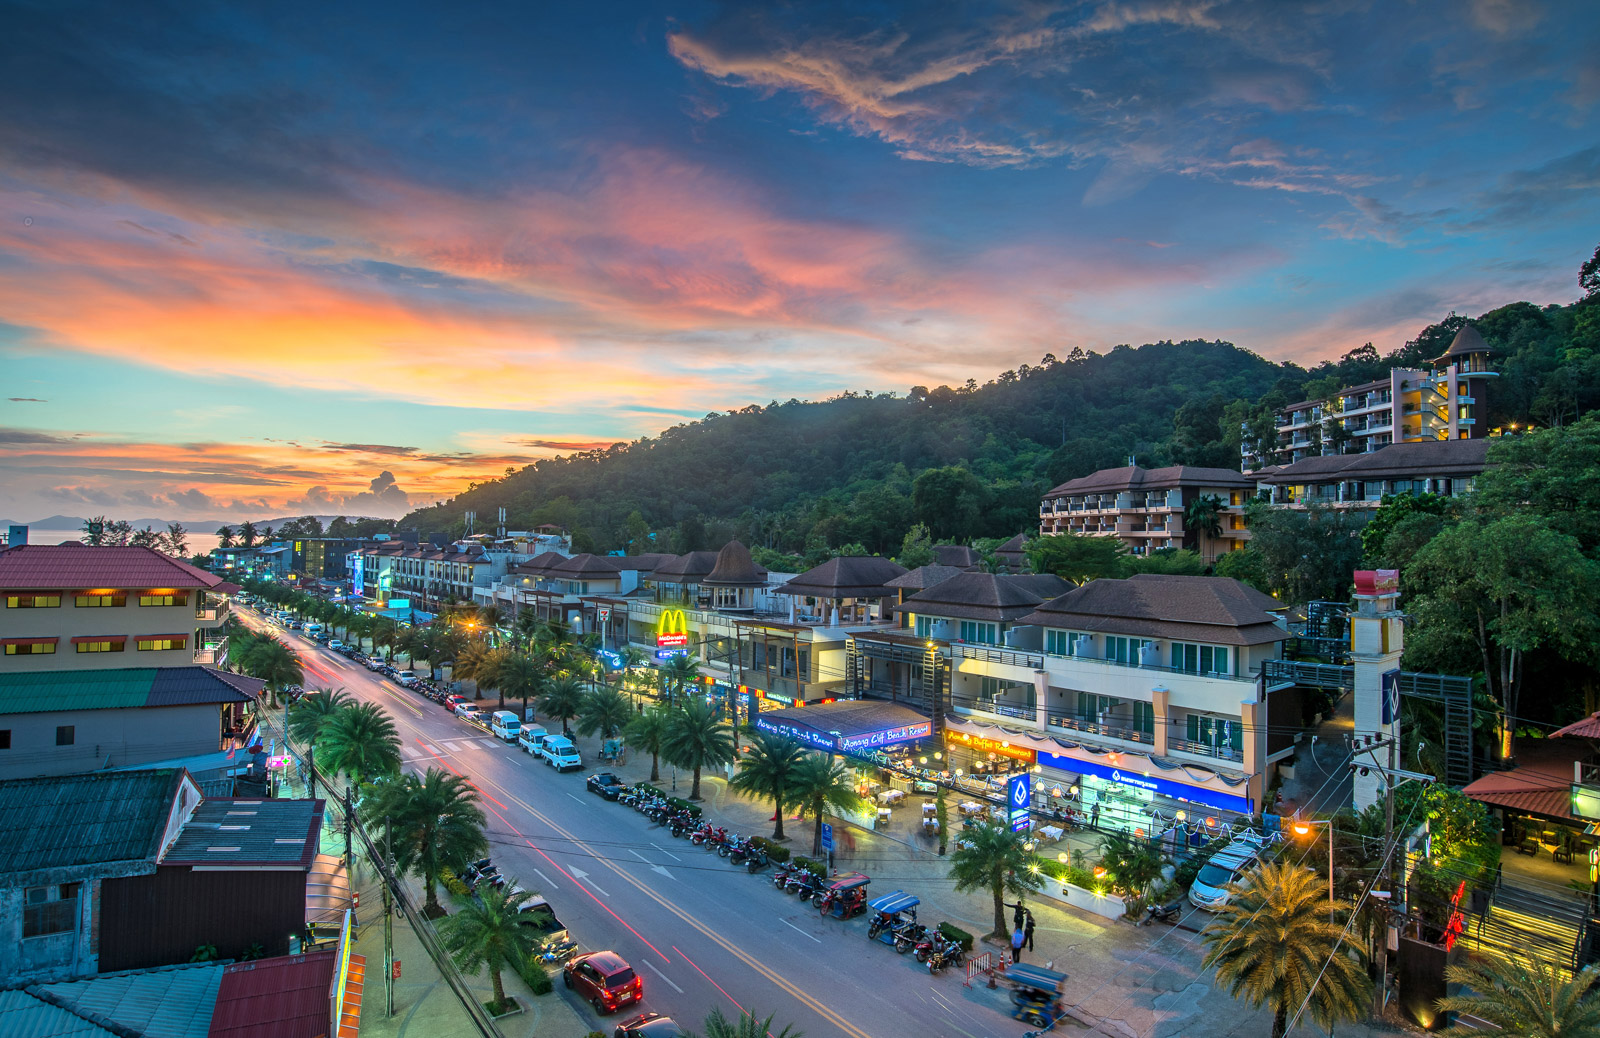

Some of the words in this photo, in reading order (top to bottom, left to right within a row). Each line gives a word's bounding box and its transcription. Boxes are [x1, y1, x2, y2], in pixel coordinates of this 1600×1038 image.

[813, 734, 833, 747] Resort
[843, 738, 868, 748] Aonang
[871, 732, 885, 744] Cliff
[887, 728, 907, 740] Beach
[909, 725, 929, 736] Resort
[973, 737, 993, 749] Buffet
[995, 742, 1032, 757] Restaurant
